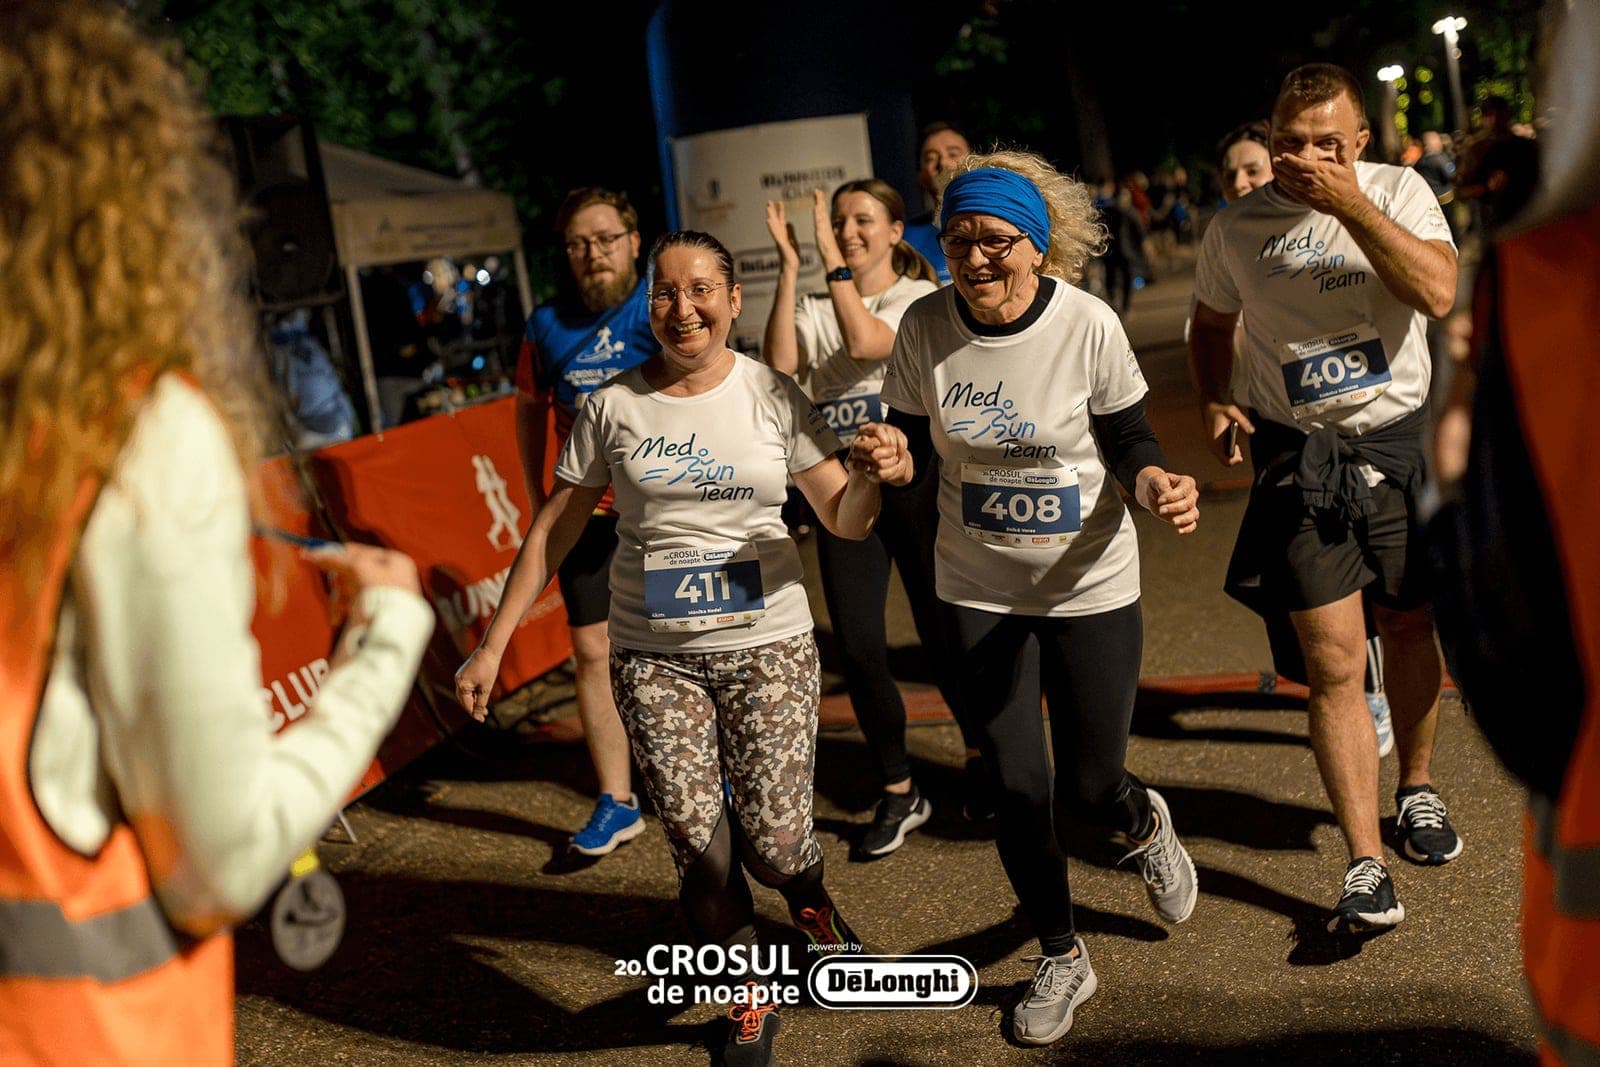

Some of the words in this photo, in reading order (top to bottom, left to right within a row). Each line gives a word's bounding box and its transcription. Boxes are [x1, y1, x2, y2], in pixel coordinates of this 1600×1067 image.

[1260, 227, 1313, 259] Med
[1313, 270, 1366, 294] Team
[1300, 350, 1369, 389] 409
[942, 381, 1003, 408] Med
[822, 400, 871, 429] 202
[631, 433, 696, 460] Med
[997, 438, 1057, 459] Team
[695, 481, 754, 502] Team
[981, 492, 1062, 523] 408
[674, 570, 731, 604] 411
